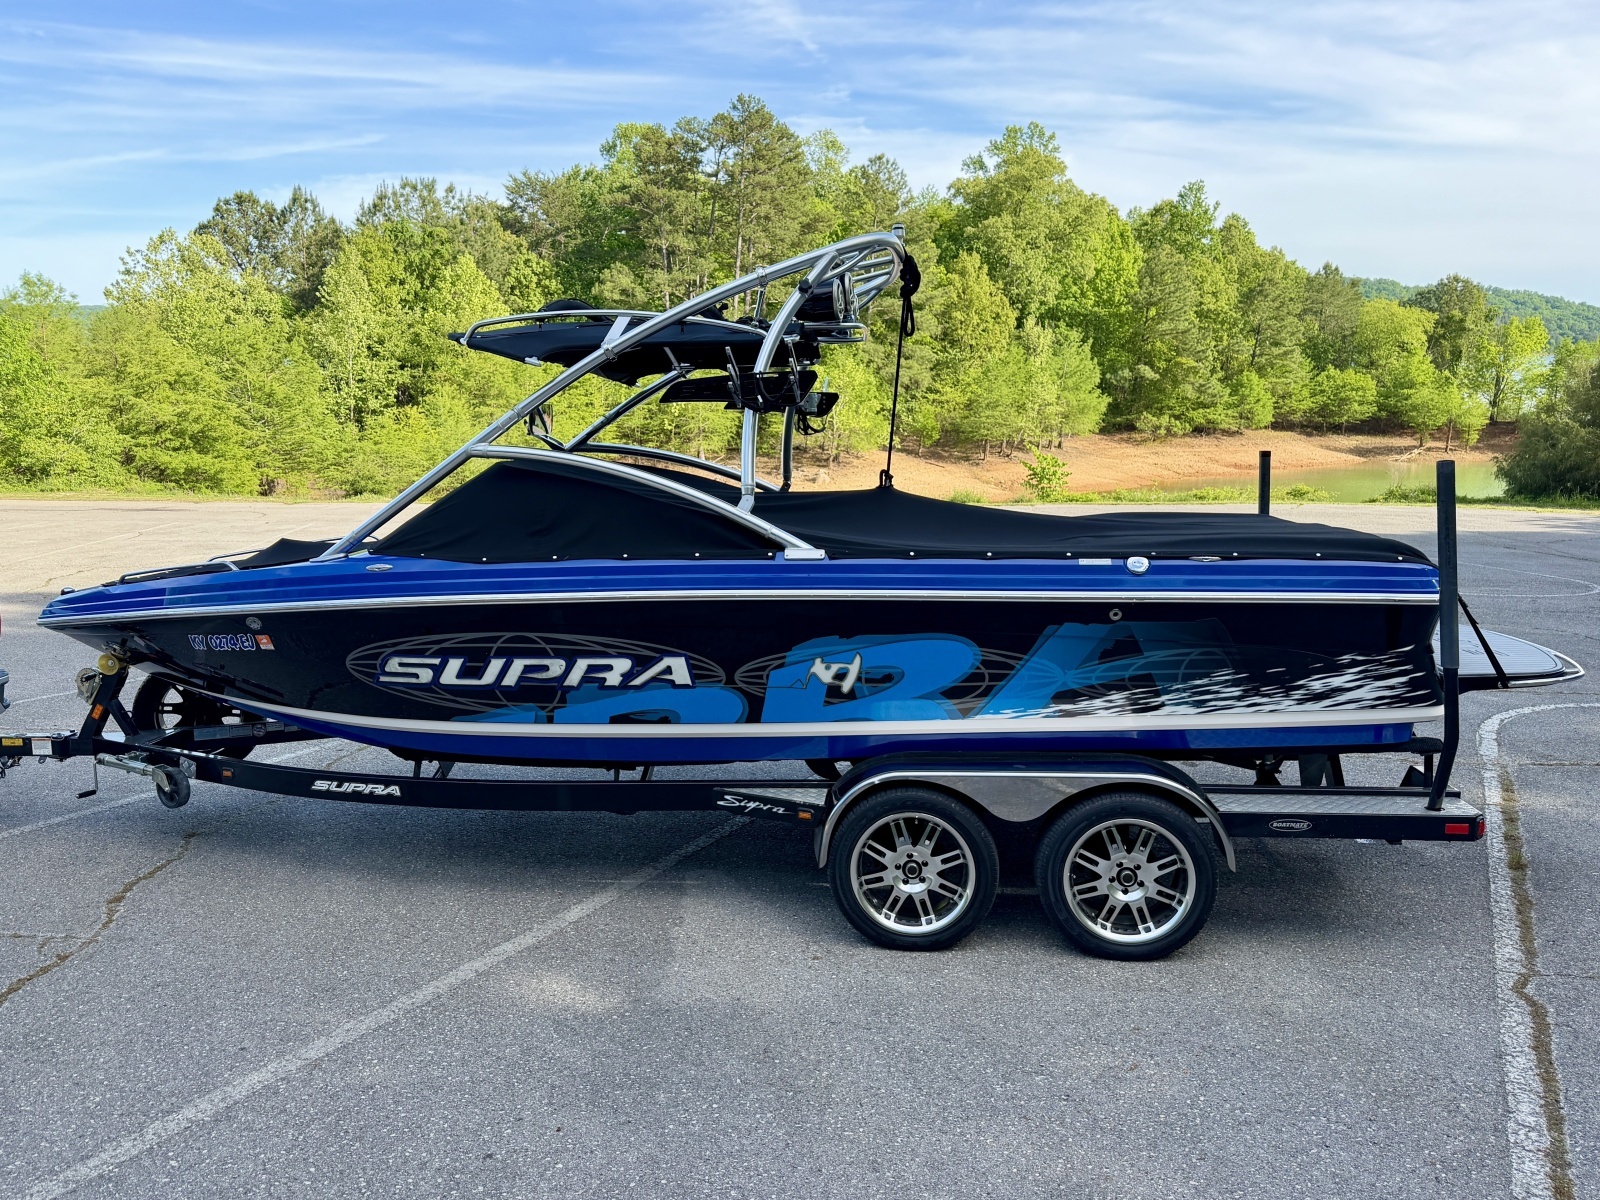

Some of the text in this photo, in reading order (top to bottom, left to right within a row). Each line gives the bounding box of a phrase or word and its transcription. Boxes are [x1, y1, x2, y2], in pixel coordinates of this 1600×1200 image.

[376, 655, 695, 689] SUPRA
[310, 780, 401, 797] SUPRA
[716, 795, 795, 813] Supra
